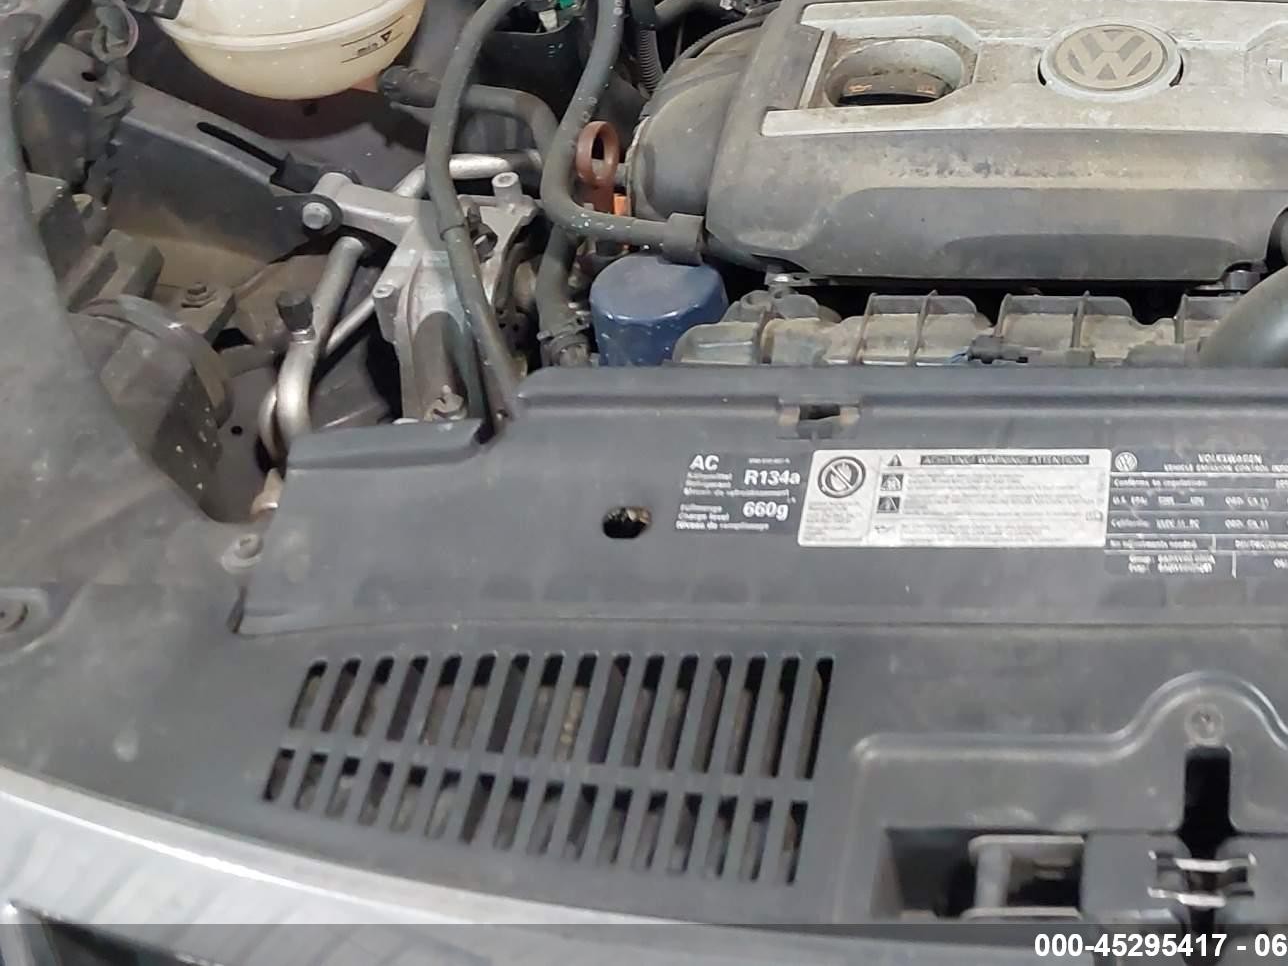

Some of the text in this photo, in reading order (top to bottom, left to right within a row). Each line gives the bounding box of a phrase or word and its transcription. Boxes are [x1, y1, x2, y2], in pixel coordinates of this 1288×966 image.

[689, 454, 720, 471] AC
[744, 469, 801, 486] R134a
[743, 501, 790, 521] 660g
